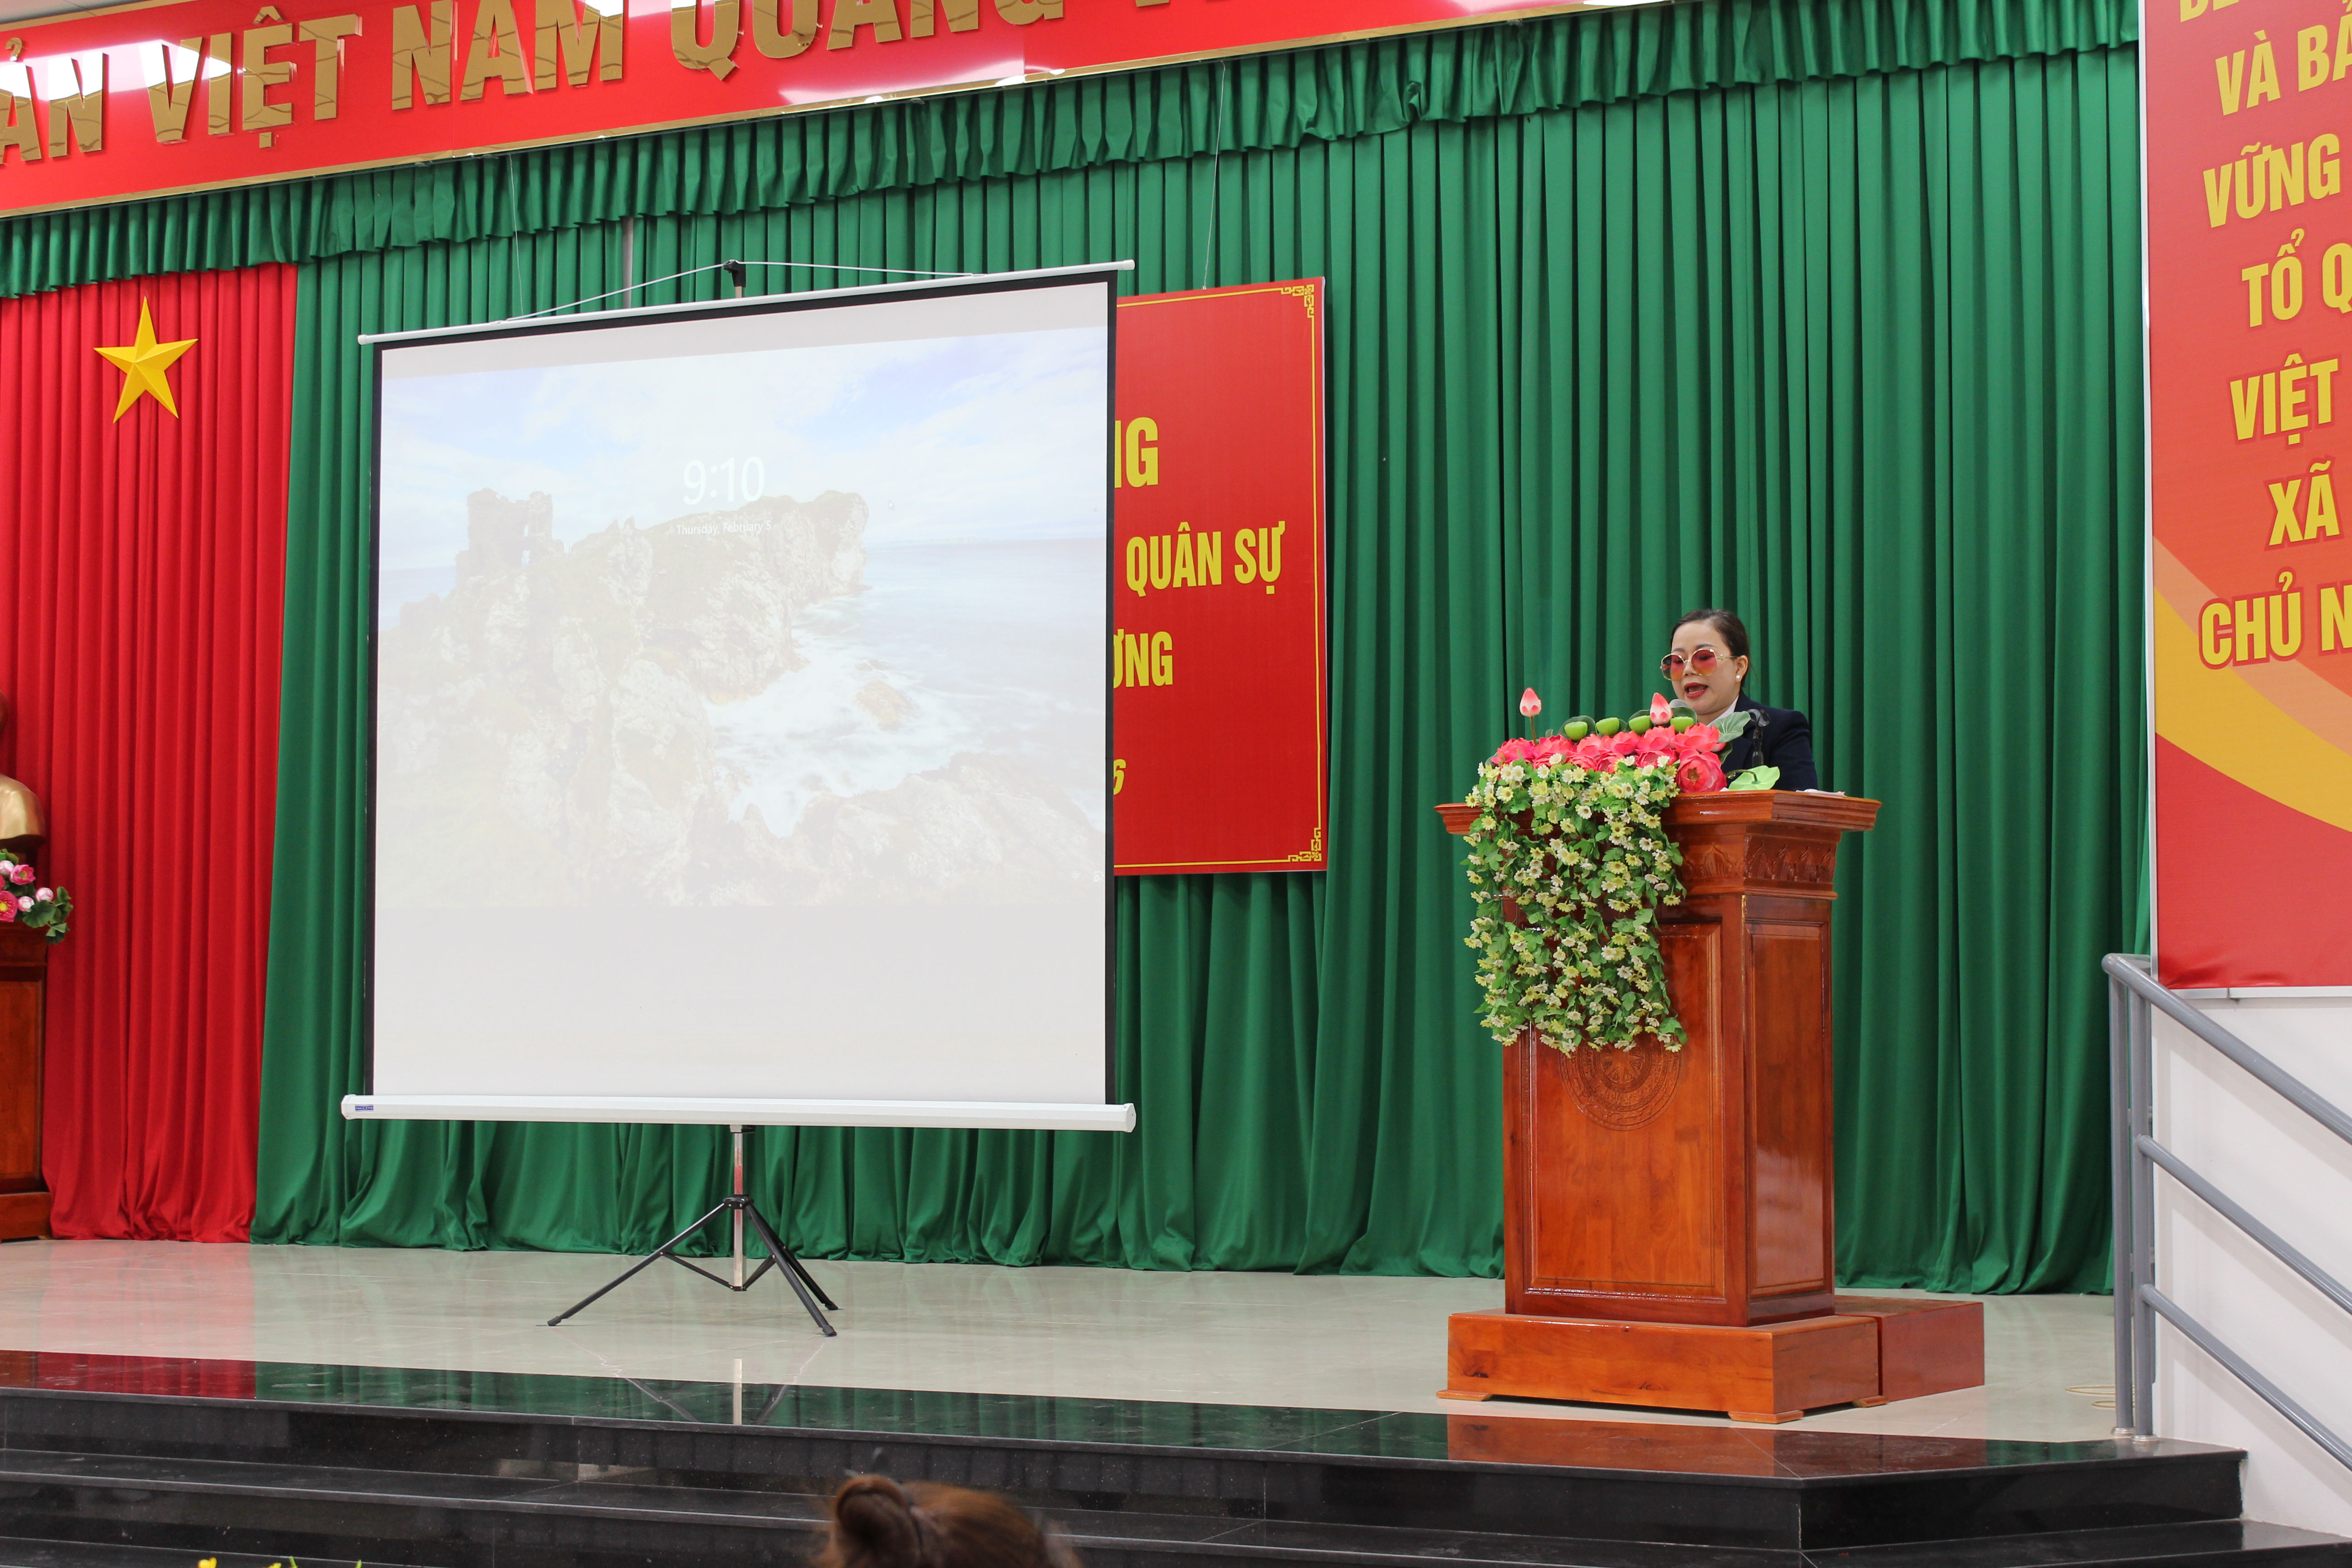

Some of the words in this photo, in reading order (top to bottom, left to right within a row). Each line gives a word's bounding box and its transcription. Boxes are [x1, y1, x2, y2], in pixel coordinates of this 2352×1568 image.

[140, 5, 362, 149] VIỆT
[392, 0, 623, 110] NAM
[2215, 29, 2281, 116] VÀ
[2203, 133, 2340, 228] VỮNG
[2242, 228, 2304, 328] TỔ
[2230, 353, 2338, 445] VIỆT
[683, 456, 765, 505] 9:10
[1114, 417, 1158, 488] G
[676, 523, 720, 536] Thursday,
[723, 521, 764, 534] February
[766, 520, 772, 530] 5
[2269, 460, 2340, 546] XÃ
[1126, 522, 1222, 598] QUÂN
[1235, 520, 1285, 595] SỰ
[2202, 571, 2301, 666] CHỦ
[2320, 584, 2352, 652] N
